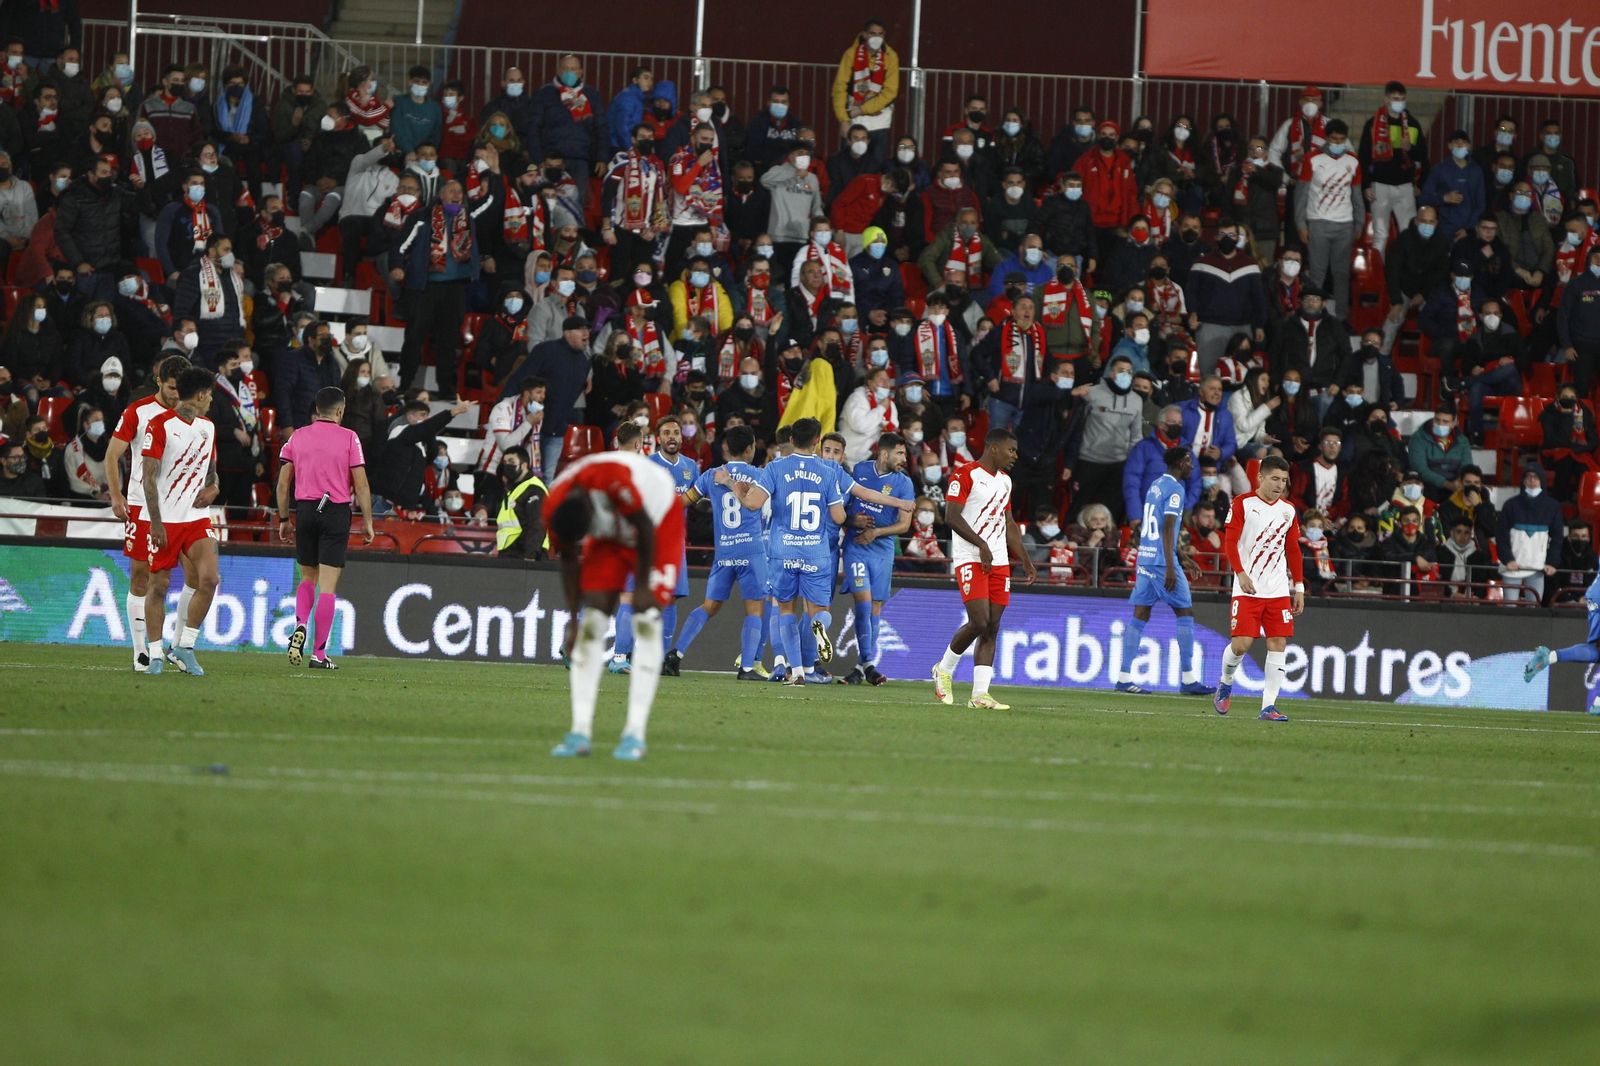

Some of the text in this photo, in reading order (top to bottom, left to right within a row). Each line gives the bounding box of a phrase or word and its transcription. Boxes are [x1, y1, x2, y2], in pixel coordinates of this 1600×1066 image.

[794, 470, 822, 485] PULIDO
[722, 492, 742, 530] 8
[786, 491, 821, 532] 15
[125, 521, 137, 540] 22
[1140, 502, 1160, 541] 16
[851, 562, 866, 577] 12
[960, 564, 973, 582] 15
[1231, 599, 1239, 617] 8
